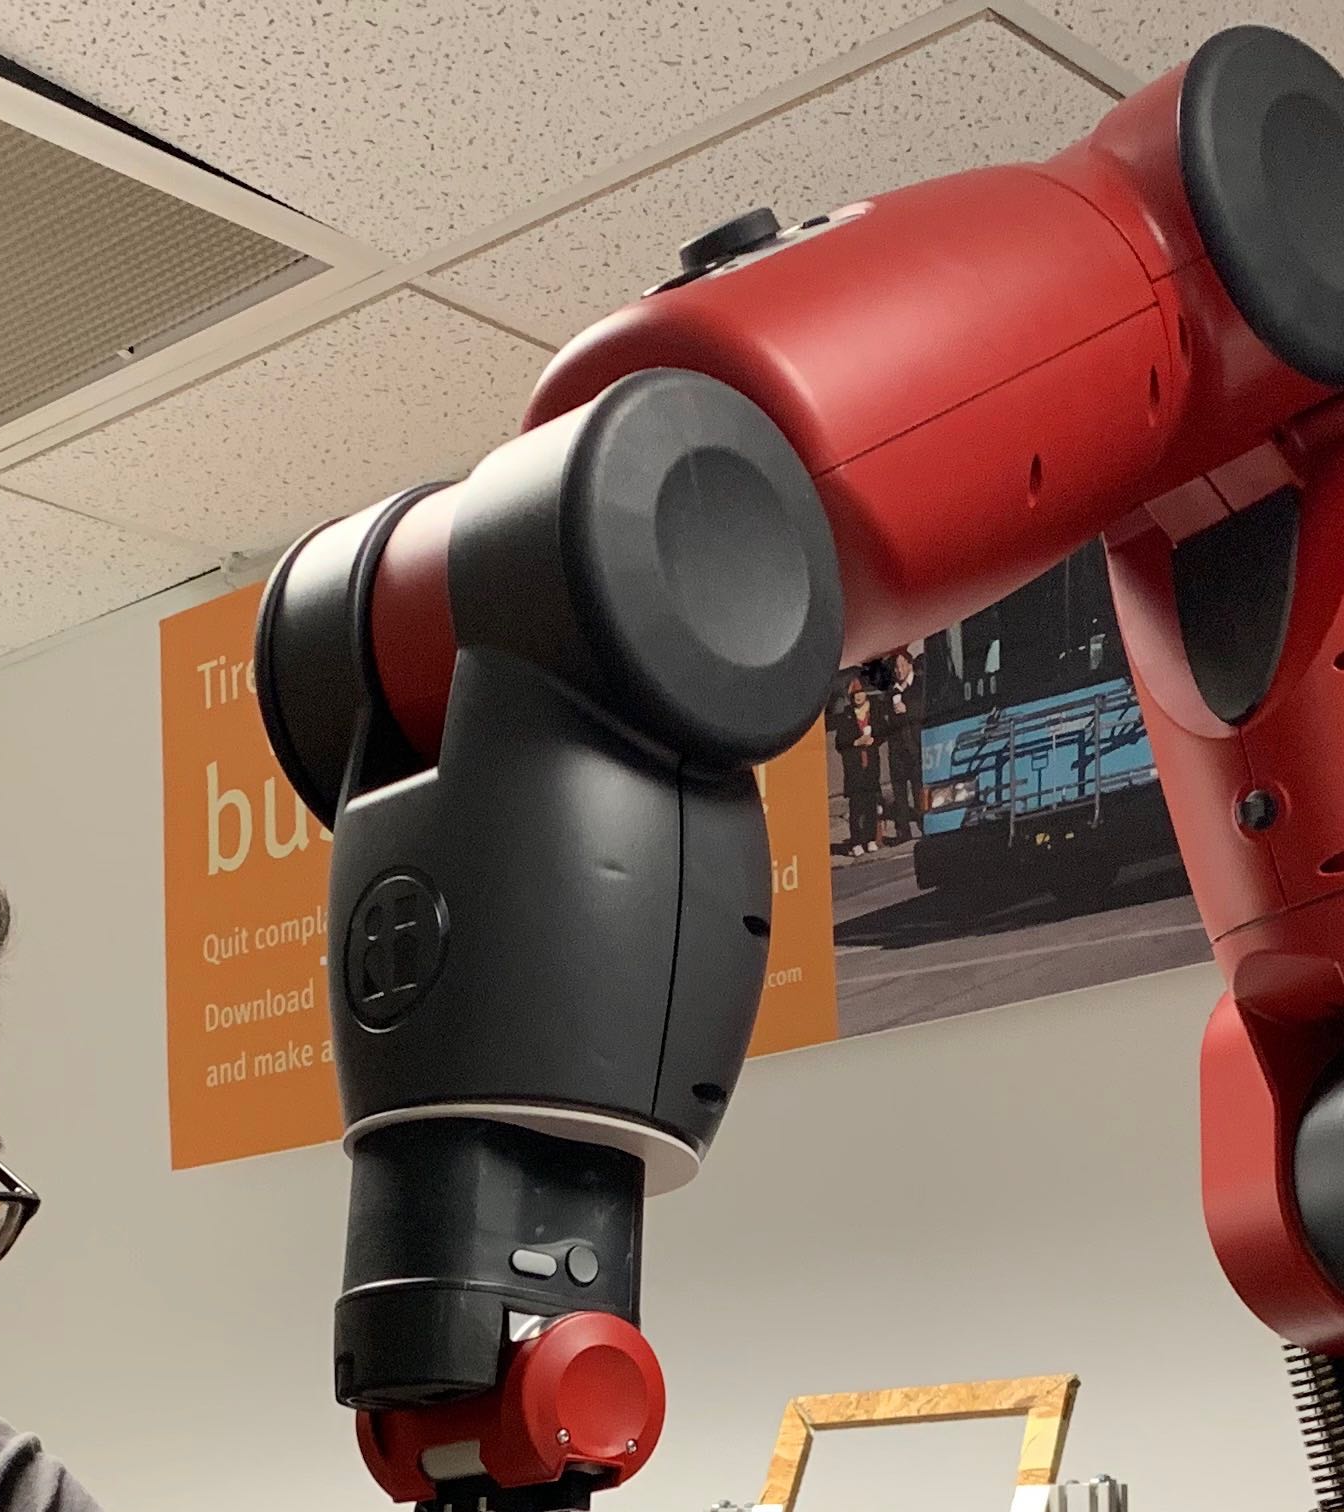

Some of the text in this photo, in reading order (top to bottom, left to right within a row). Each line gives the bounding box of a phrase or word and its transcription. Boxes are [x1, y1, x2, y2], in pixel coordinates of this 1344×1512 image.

[206, 759, 334, 876] bu
[202, 926, 249, 966] Quit
[206, 977, 315, 1033] Download
[206, 1051, 247, 1089] and
[254, 1039, 314, 1078] make
